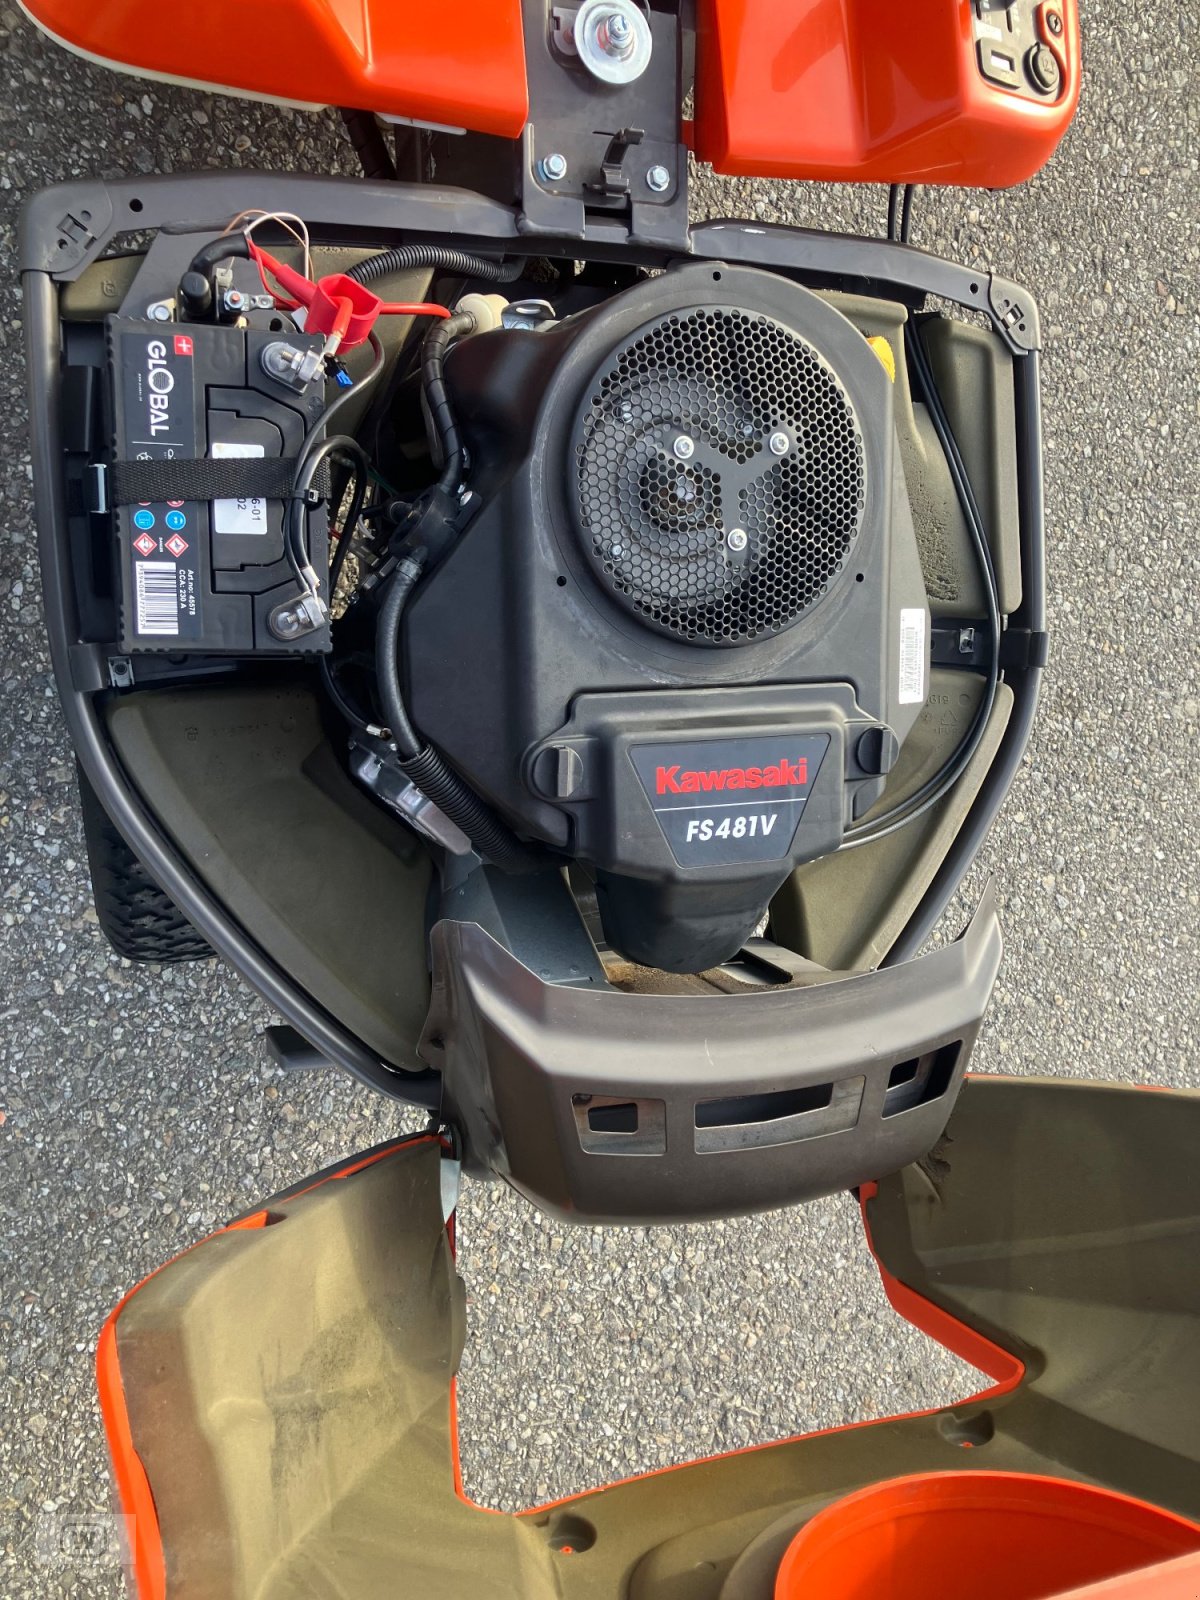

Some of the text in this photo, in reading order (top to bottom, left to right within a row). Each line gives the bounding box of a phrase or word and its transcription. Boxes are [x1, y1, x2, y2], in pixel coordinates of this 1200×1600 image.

[147, 340, 175, 437] GLOBAL
[656, 757, 808, 795] Kawasaki
[686, 814, 778, 842] FS481V
